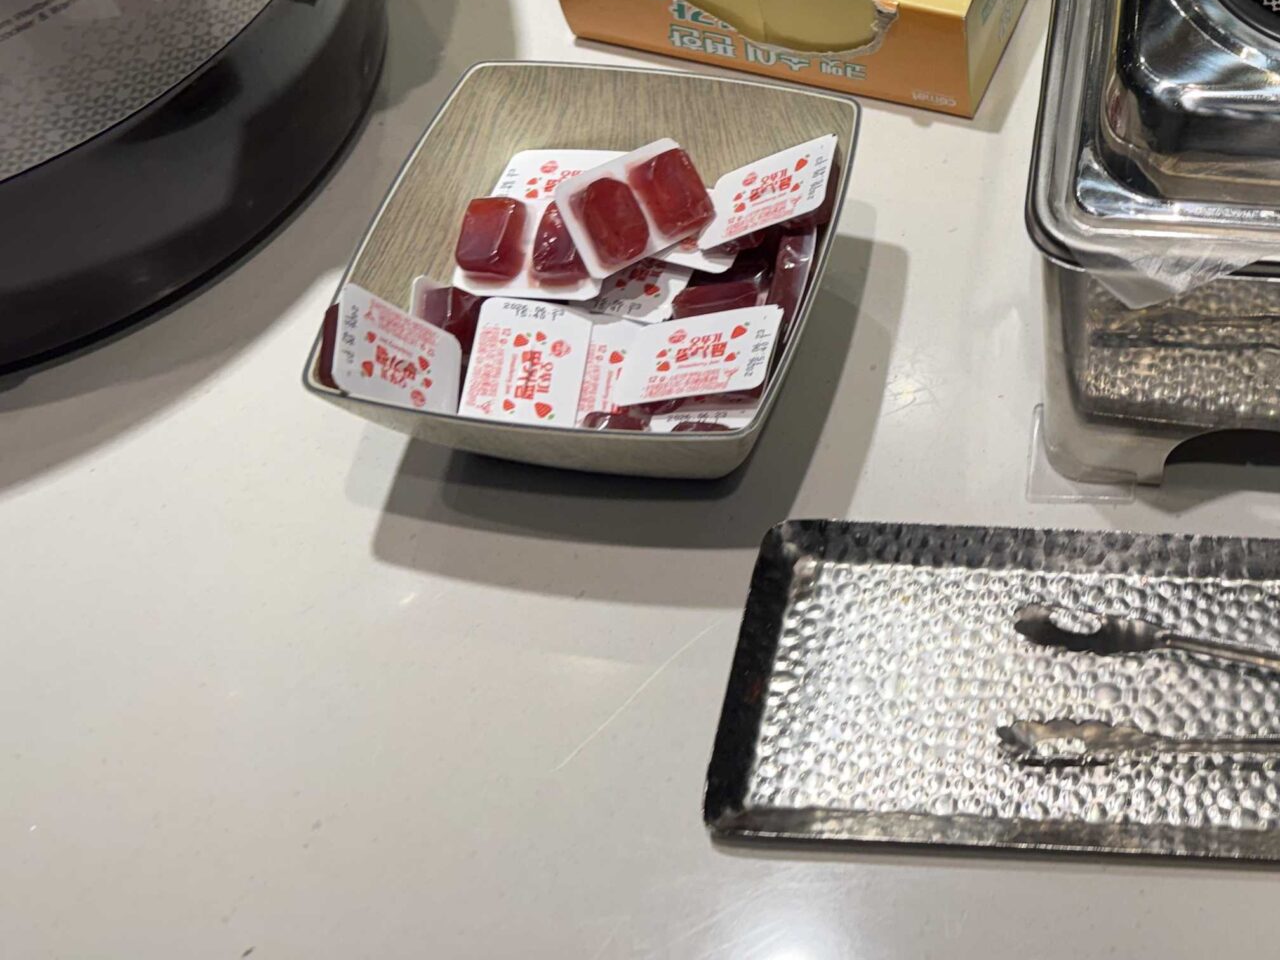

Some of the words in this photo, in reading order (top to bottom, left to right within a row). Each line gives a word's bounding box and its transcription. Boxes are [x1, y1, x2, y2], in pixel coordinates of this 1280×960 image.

[668, 23, 735, 59] 편한
[819, 57, 866, 82] 코멧
[911, 90, 956, 107] comet
[760, 167, 788, 186] 오뚜기
[690, 332, 722, 345] 오뚜기
[536, 361, 553, 393] 오뚜기
